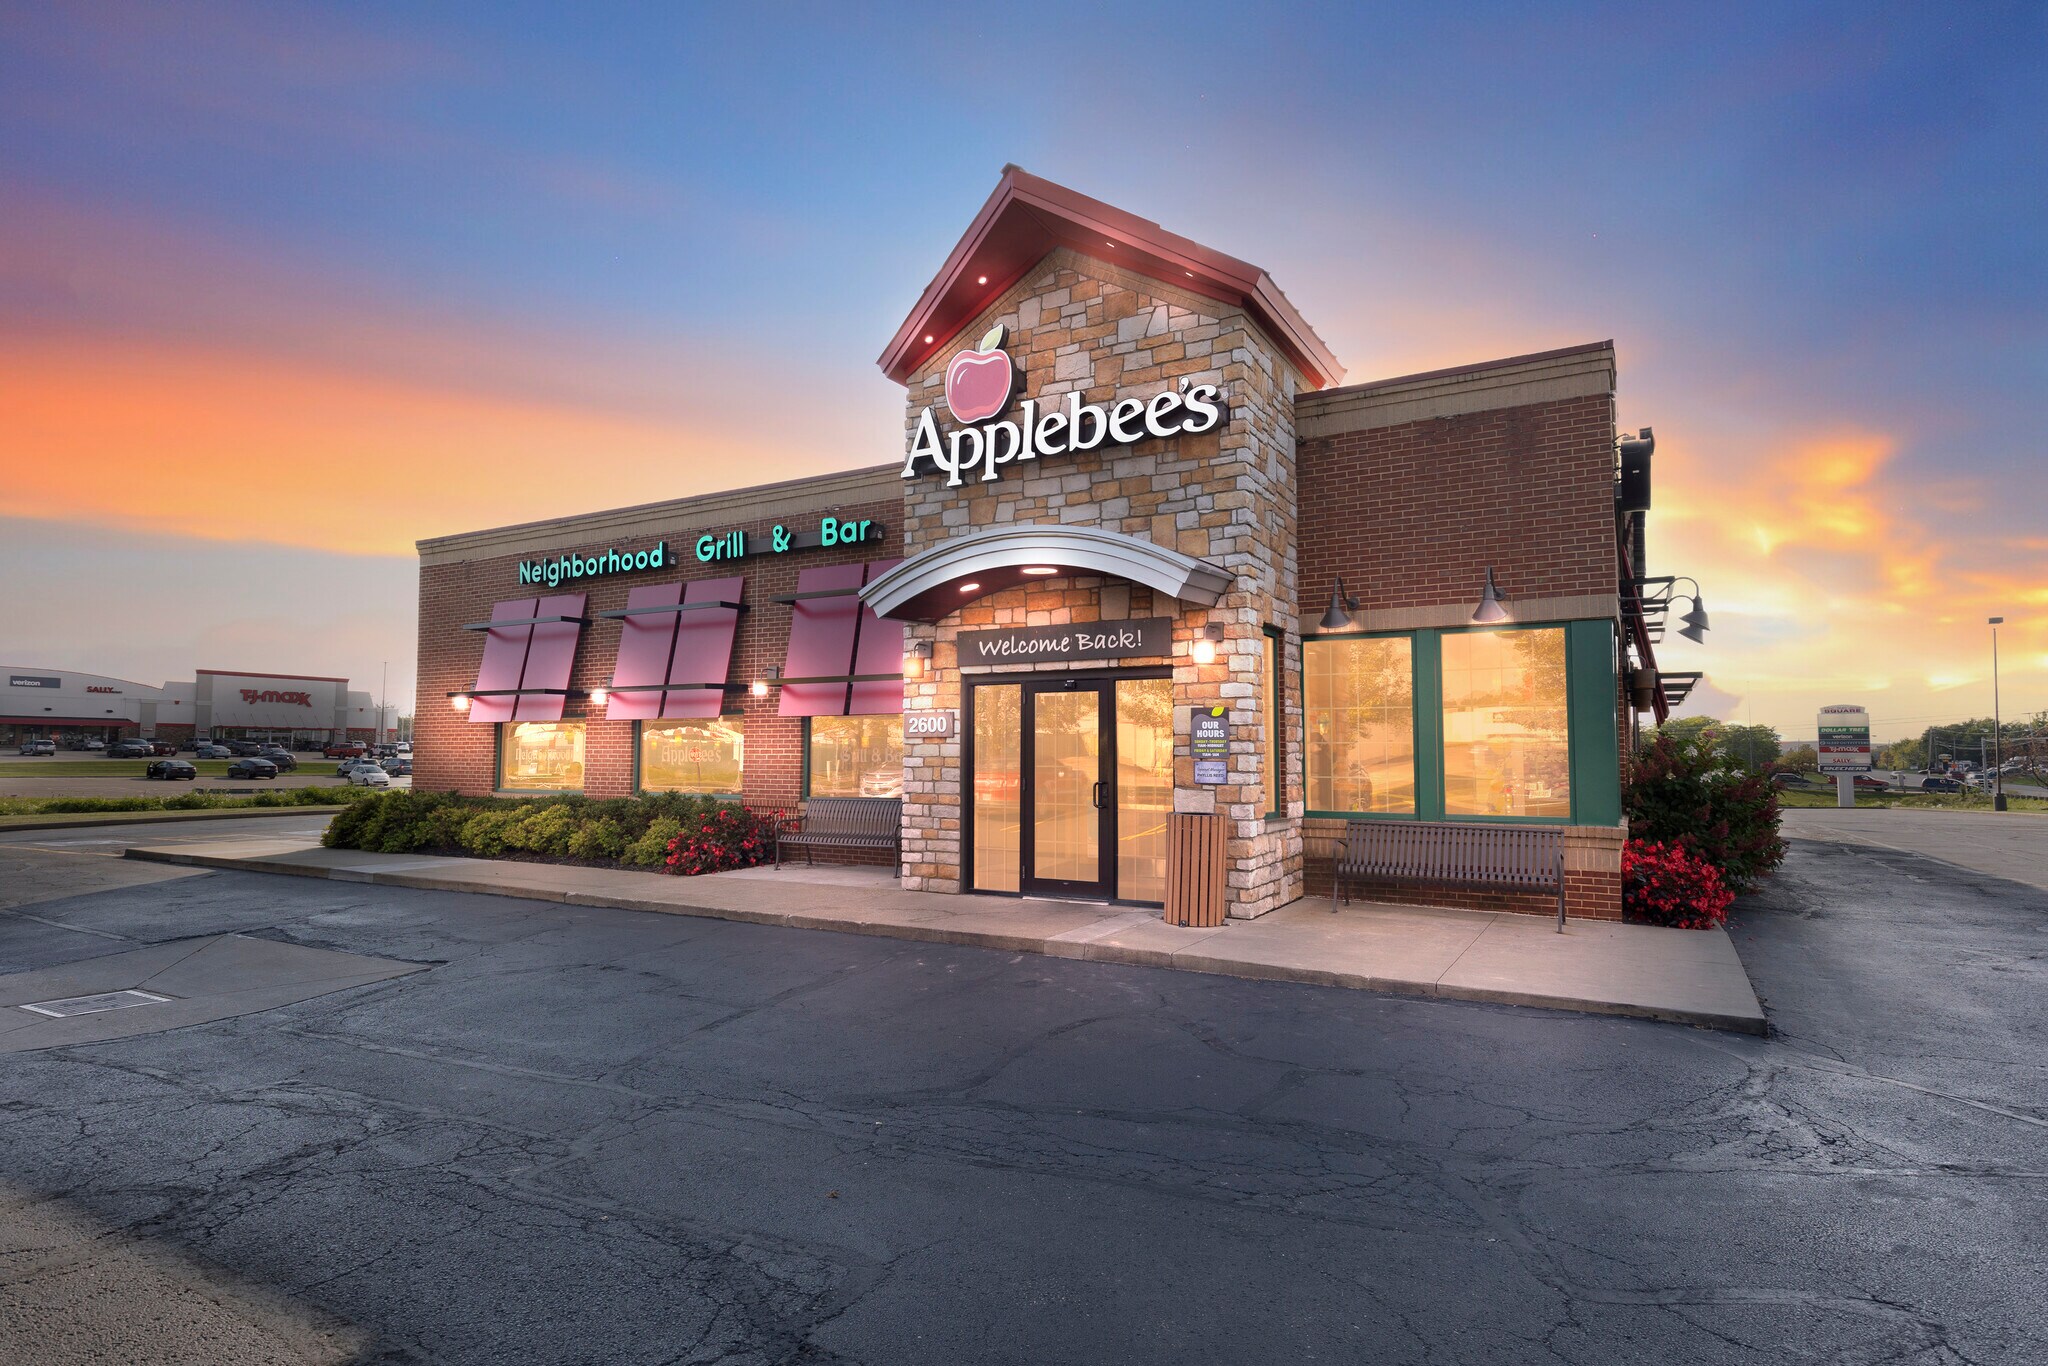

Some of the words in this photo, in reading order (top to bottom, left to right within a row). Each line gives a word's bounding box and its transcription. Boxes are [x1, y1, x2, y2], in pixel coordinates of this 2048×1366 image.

[900, 376, 1220, 488] Applebee's
[519, 541, 664, 588] Neighborhood
[696, 530, 744, 562] Grill
[772, 525, 792, 552] &
[821, 517, 871, 546] Bar
[978, 635, 1070, 656] Welcome
[1075, 628, 1143, 651] Back!
[86, 686, 114, 694] SALLY
[908, 716, 947, 733] 2600
[1202, 721, 1219, 729] OUR
[1197, 730, 1225, 738] HOURS
[871, 747, 882, 763] &
